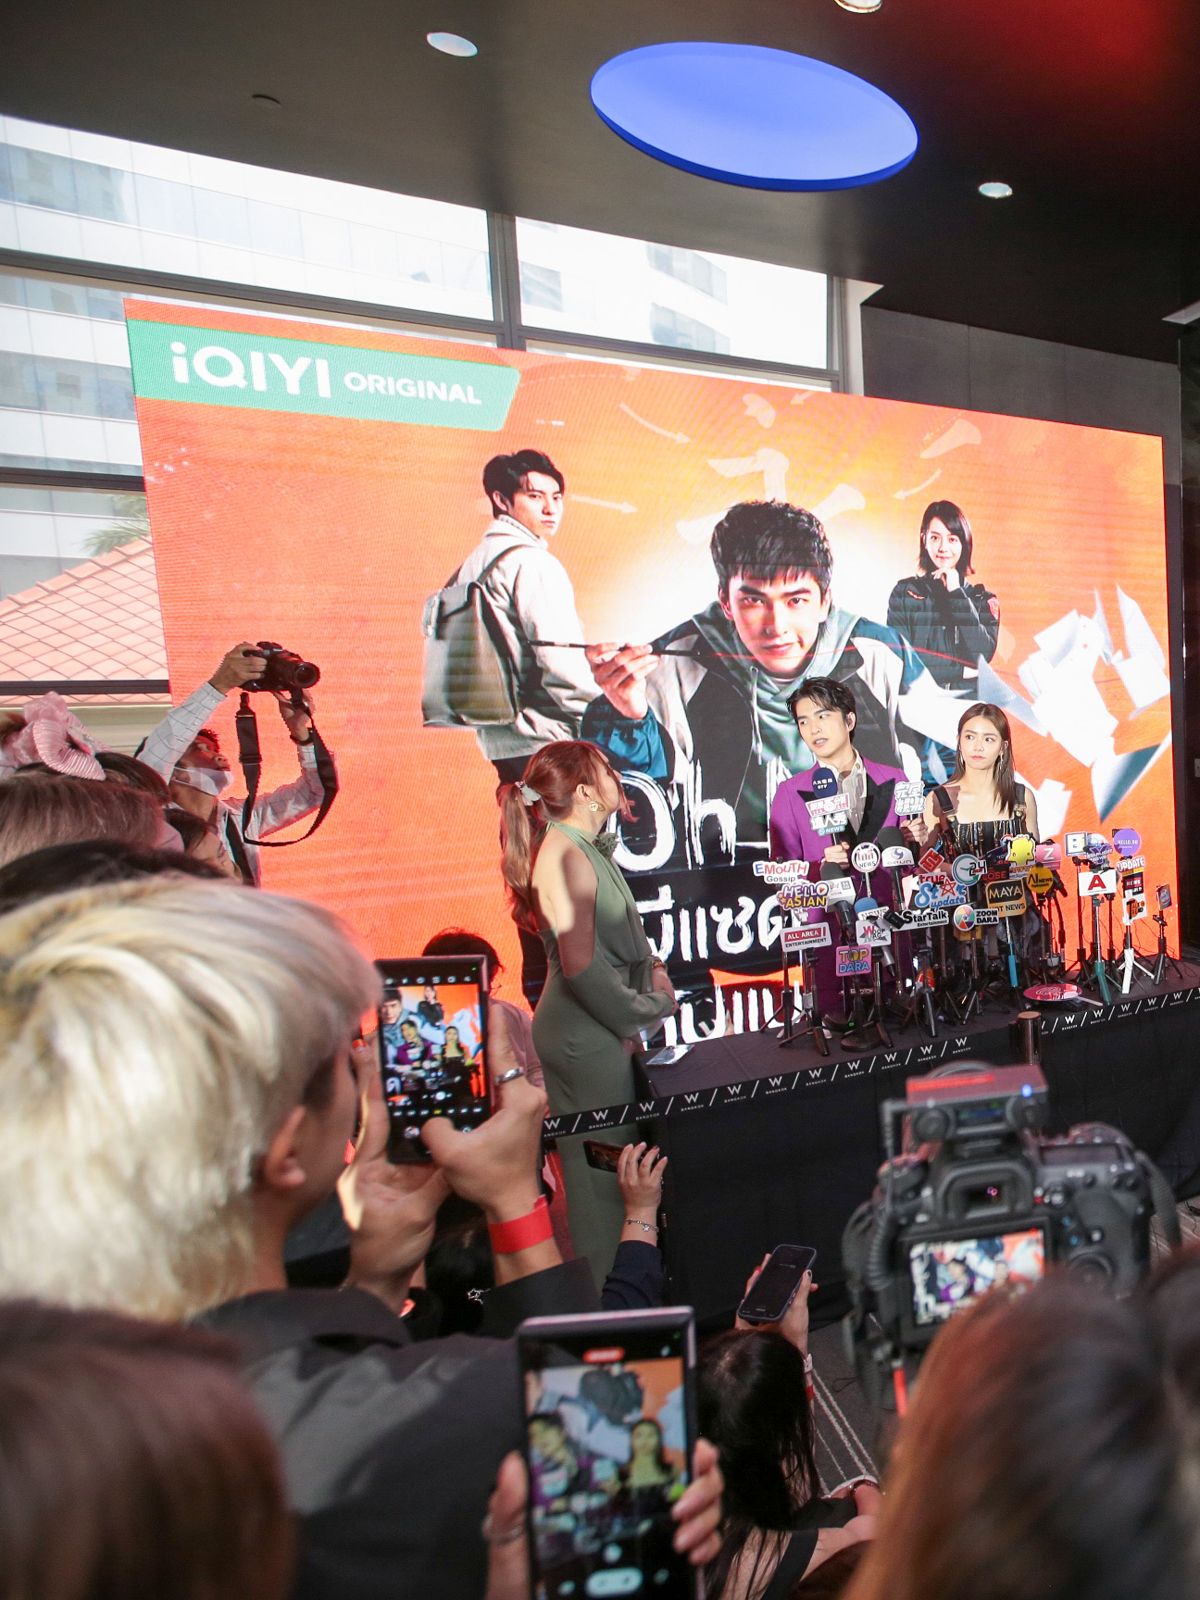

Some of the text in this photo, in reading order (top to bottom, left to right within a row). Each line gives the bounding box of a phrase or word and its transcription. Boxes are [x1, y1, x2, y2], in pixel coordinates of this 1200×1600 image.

[170, 341, 482, 405] iQIYI ORIGINAL
[1118, 857, 1145, 872] UPDATE
[766, 875, 796, 883] Gossip
[1088, 874, 1106, 891] A
[783, 884, 829, 897] HELLO
[989, 886, 1022, 899] MAYA
[785, 895, 827, 908] ASIAN
[931, 896, 965, 909] update
[1005, 902, 1025, 911] NEWS
[902, 910, 948, 924] StarTalk
[801, 929, 820, 938] AREA
[785, 937, 827, 948] ENTERTAINMENT
[839, 949, 869, 961] TOP
[839, 961, 870, 973] DARA
[544, 1118, 560, 1129] W
[592, 1109, 608, 1121] W
[639, 1101, 655, 1112] W
[684, 1092, 699, 1104] W
[728, 1084, 742, 1095] W
[769, 1076, 782, 1087] W
[809, 1068, 822, 1078] W
[847, 1060, 861, 1070] W
[884, 1052, 898, 1062] W
[920, 1045, 933, 1055] W
[955, 1037, 967, 1047] W
[1065, 1015, 1075, 1024] W
[1093, 1009, 1103, 1018] W
[1121, 1003, 1131, 1012] W
[1148, 998, 1157, 1006] W
